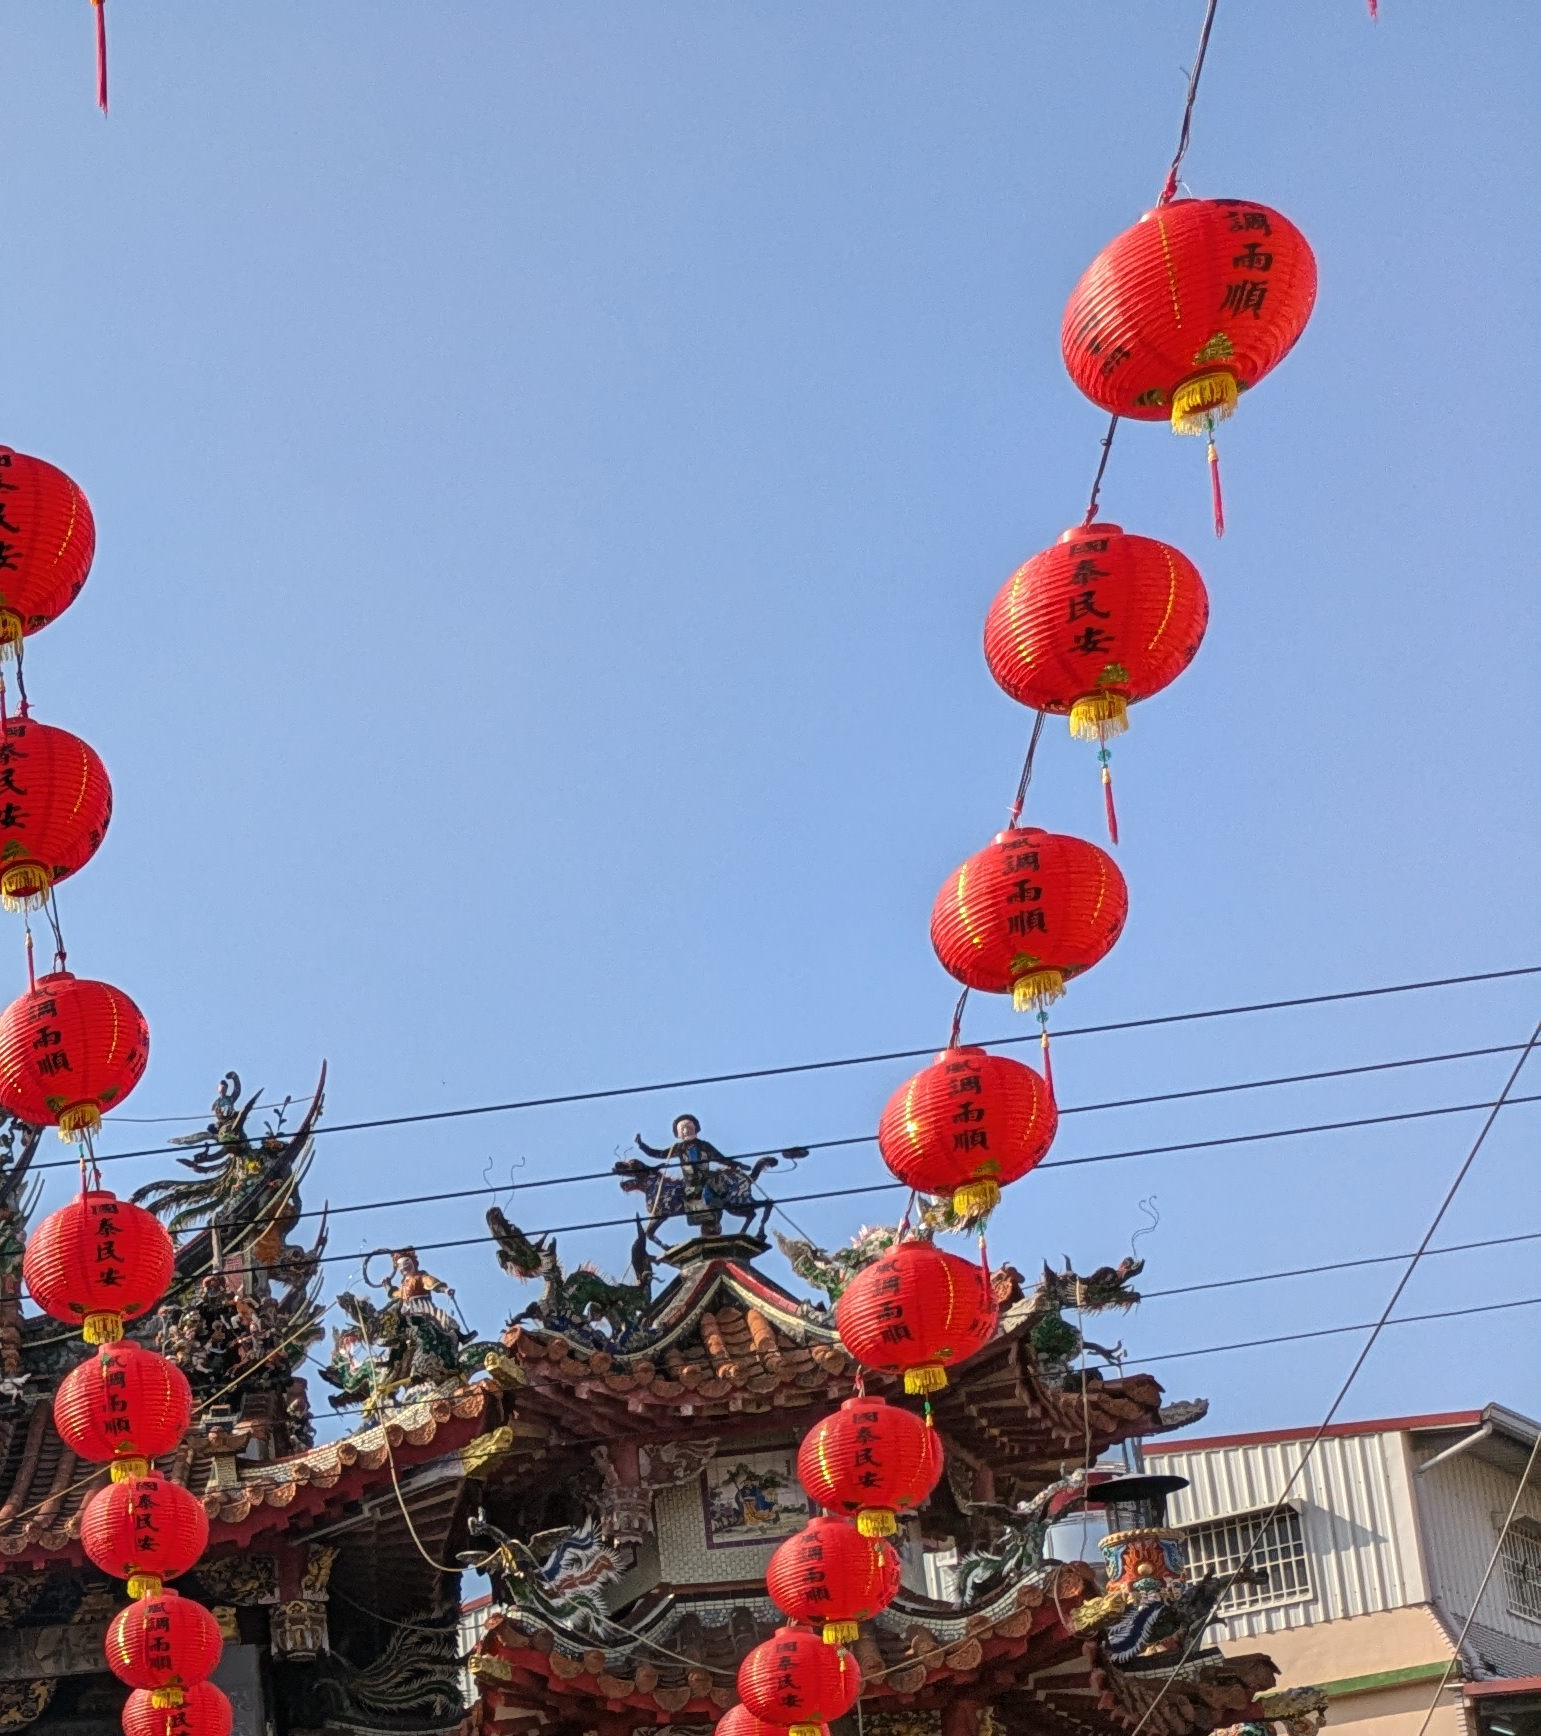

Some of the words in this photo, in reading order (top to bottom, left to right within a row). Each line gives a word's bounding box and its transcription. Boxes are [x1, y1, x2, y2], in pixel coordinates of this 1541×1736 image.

[1219, 203, 1274, 321] 調雨順
[1065, 538, 1116, 656] 國泰民安
[997, 835, 1047, 937] 風調雨順
[27, 984, 73, 1078] 風調雨順
[945, 1059, 990, 1153] 風調雨順
[90, 1203, 126, 1287] 國泰民安
[874, 1258, 915, 1345] 風調雨順
[101, 1354, 131, 1436] 風調雨順
[851, 1411, 885, 1489] 國泰民安
[134, 1481, 160, 1552] 國泰民安
[801, 1531, 834, 1604] 風調雨順
[147, 1603, 173, 1671] 風調雨順
[775, 1641, 805, 1709] 國泰民安
